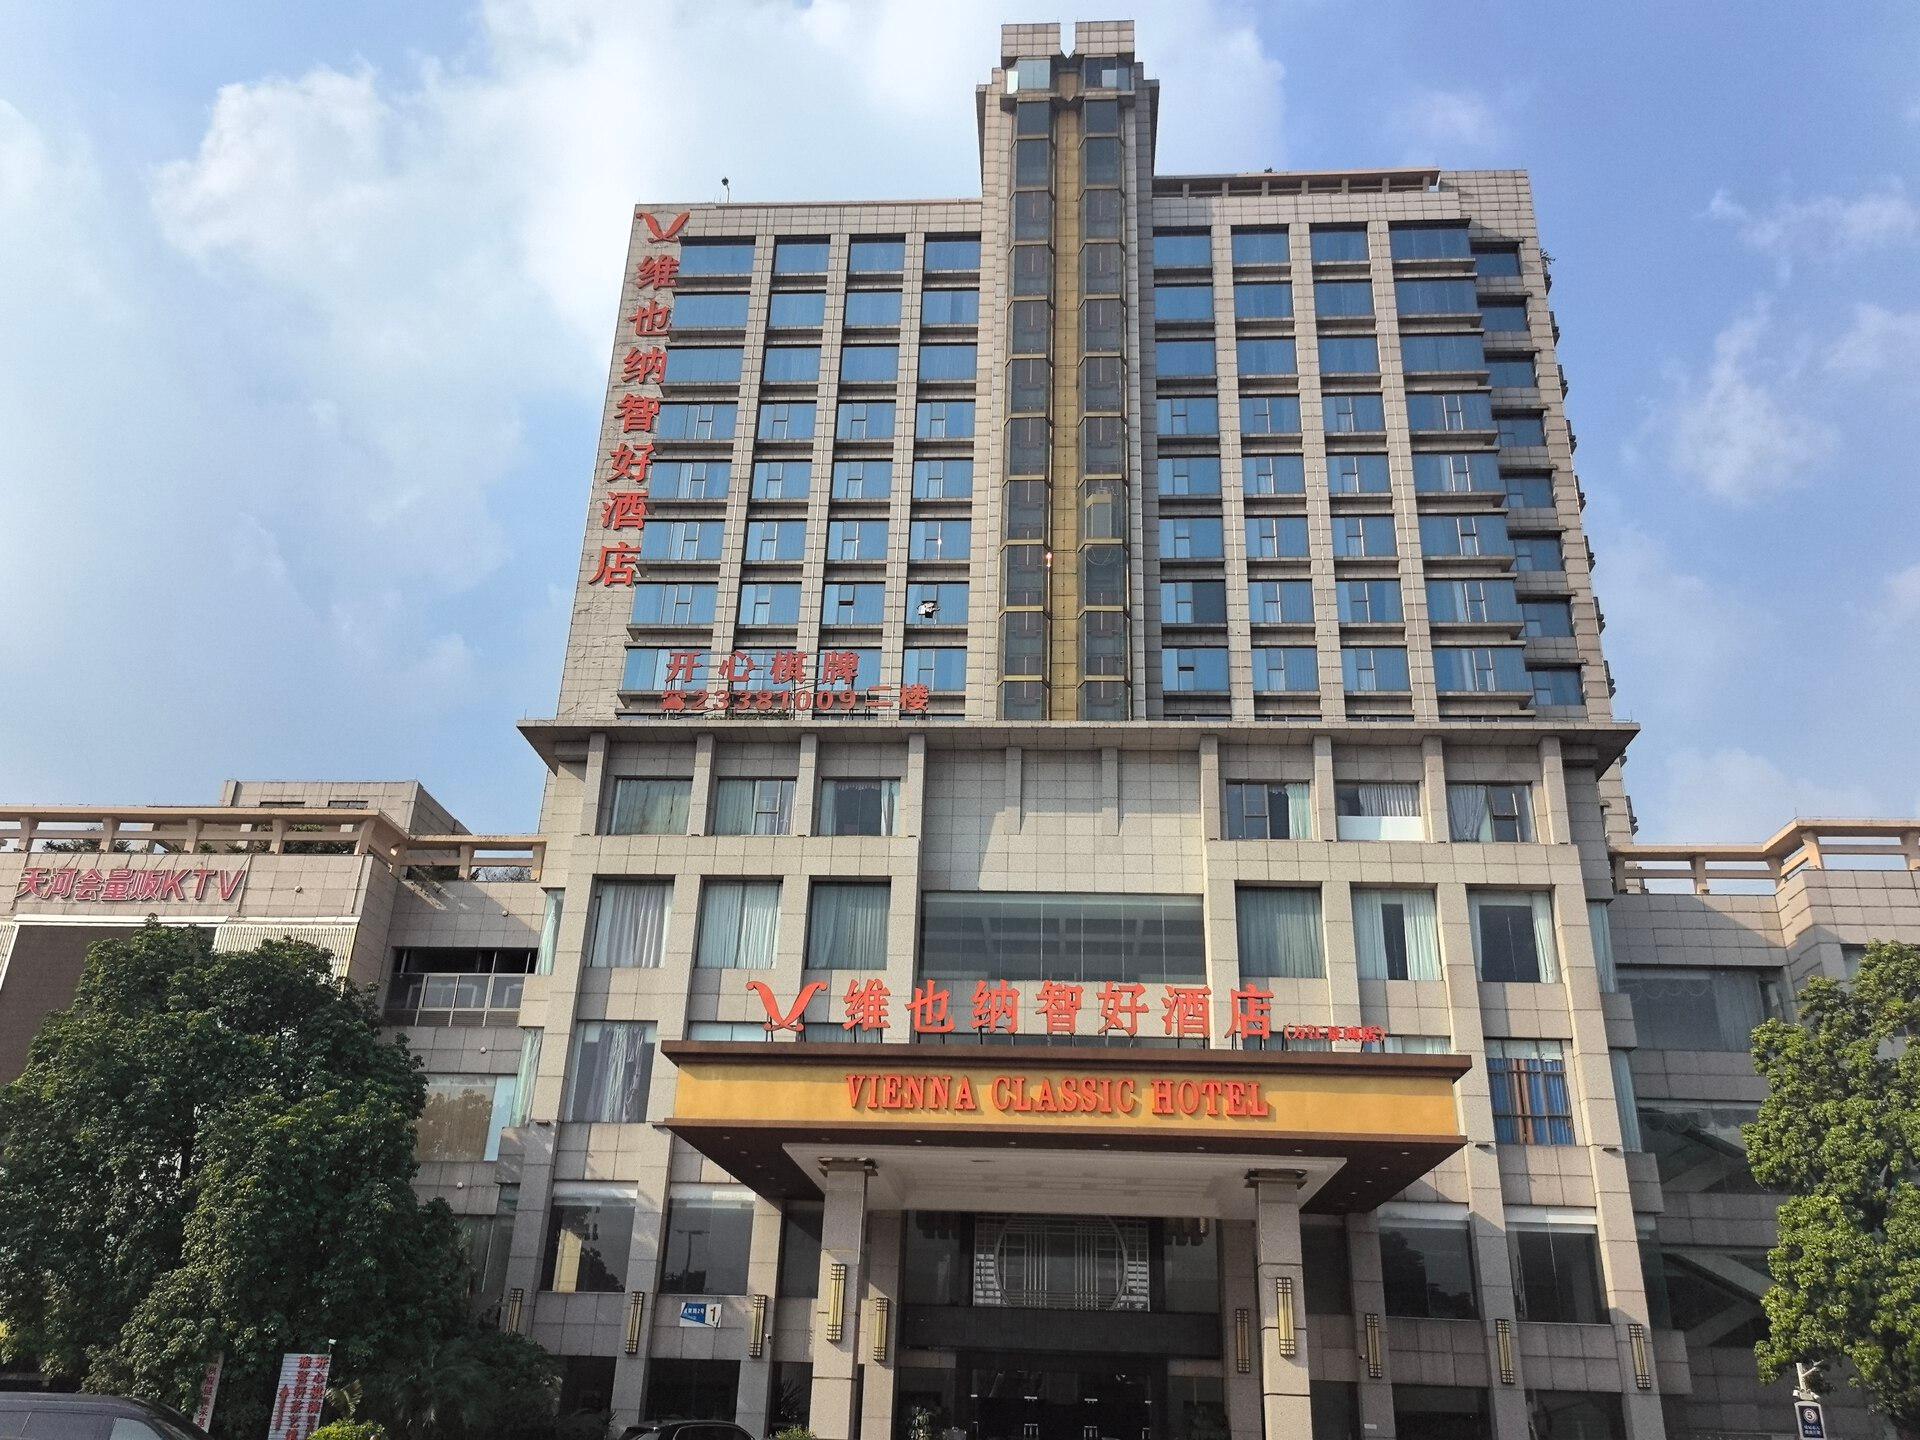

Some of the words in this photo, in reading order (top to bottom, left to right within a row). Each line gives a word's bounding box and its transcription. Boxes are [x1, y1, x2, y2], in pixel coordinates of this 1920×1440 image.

[589, 255, 680, 587] 维也纳智好酒店
[665, 650, 860, 684] 开心棋牌
[693, 689, 857, 712] 23381009
[842, 978, 1275, 1040] 维也纳智好酒店
[846, 1074, 977, 1111] VIENNA
[990, 1076, 1136, 1113] CLASSIC
[1151, 1080, 1271, 1117] HOTEL
